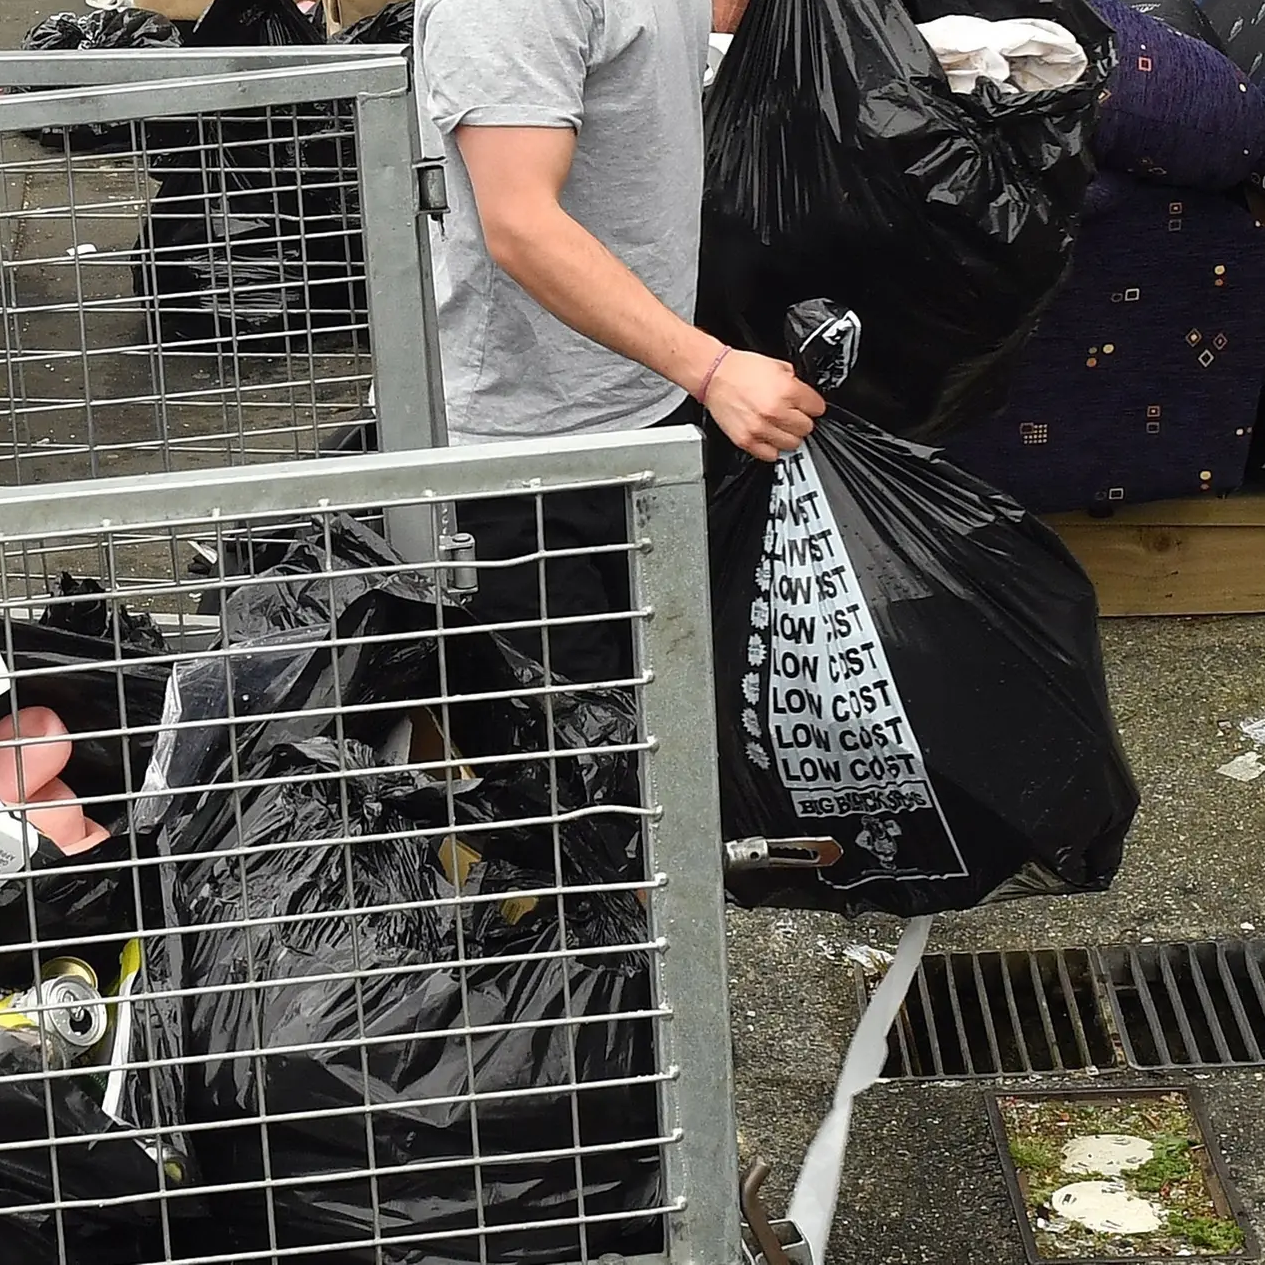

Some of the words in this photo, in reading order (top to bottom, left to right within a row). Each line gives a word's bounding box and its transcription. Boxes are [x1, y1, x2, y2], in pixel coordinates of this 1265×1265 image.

[831, 679, 891, 723] COST
[774, 723, 832, 753] LOW
[839, 716, 904, 752] COST
[782, 757, 842, 783] LOW
[849, 753, 916, 782] COST
[797, 797, 835, 816] BIG
